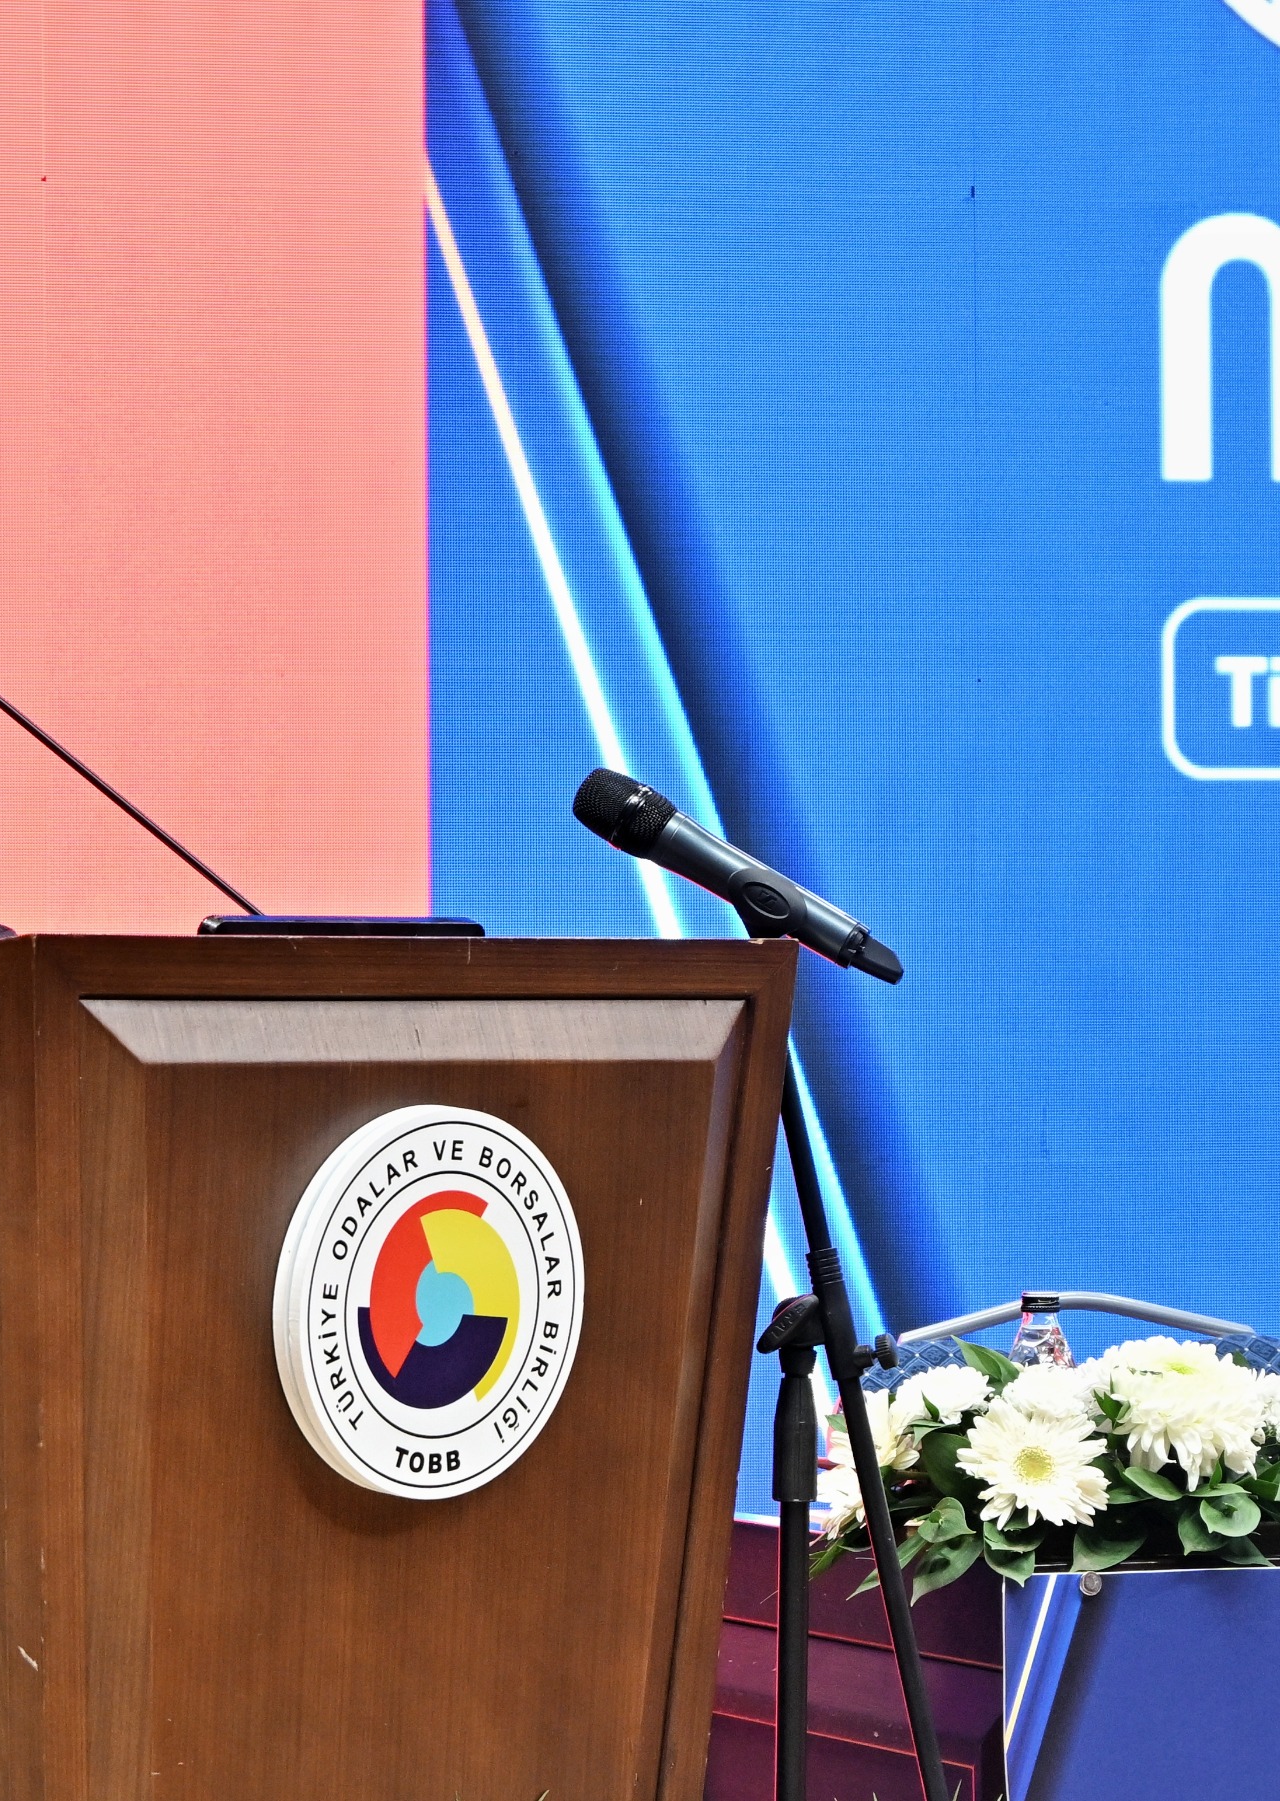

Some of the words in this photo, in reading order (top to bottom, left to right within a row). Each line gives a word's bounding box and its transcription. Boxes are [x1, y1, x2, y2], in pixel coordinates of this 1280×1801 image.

[331, 1149, 419, 1261] ODALAR
[432, 1139, 465, 1162] VE
[477, 1145, 563, 1299] BORSALAR
[317, 1282, 365, 1432] TÜRKİYE
[492, 1321, 560, 1444] BİRLİĞİ
[394, 1445, 462, 1475] TOBB
